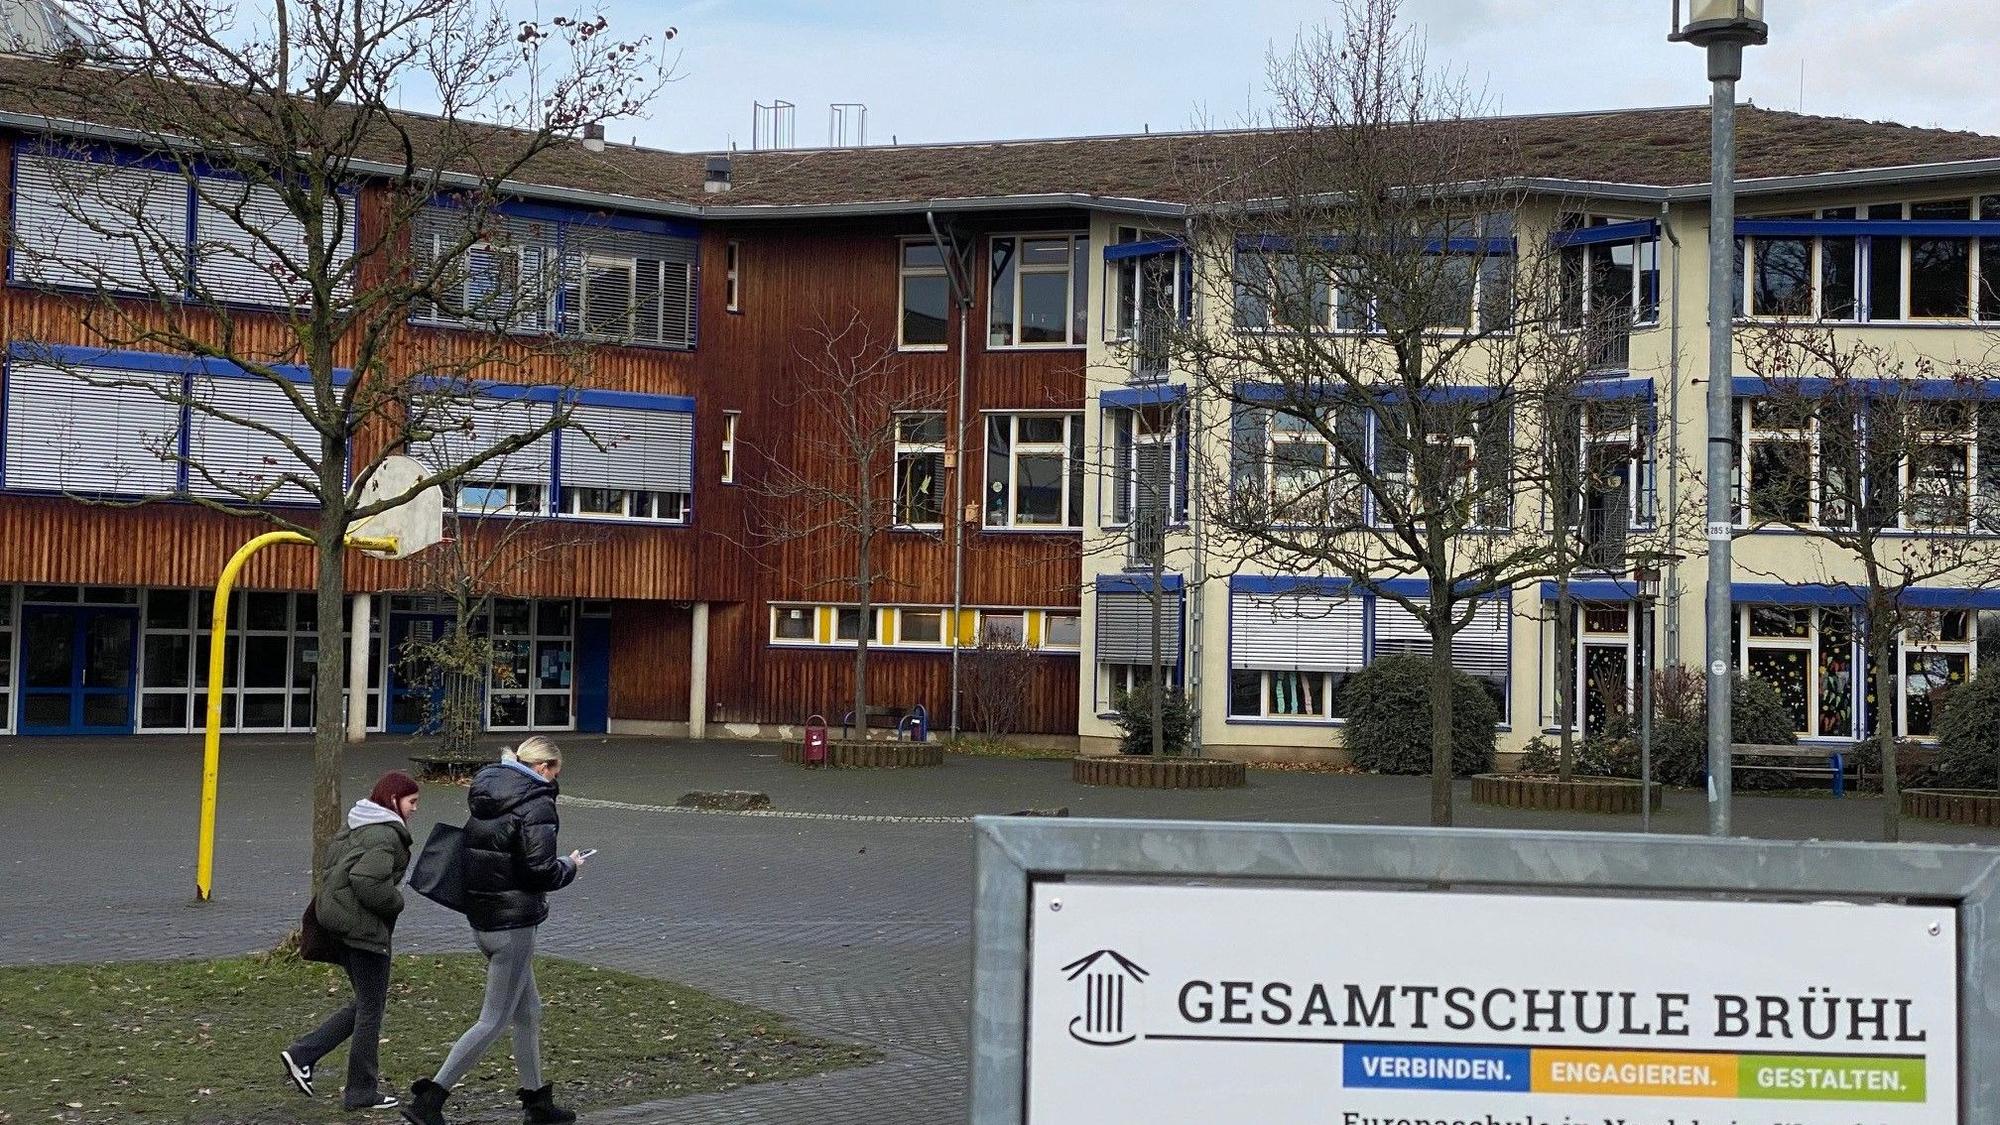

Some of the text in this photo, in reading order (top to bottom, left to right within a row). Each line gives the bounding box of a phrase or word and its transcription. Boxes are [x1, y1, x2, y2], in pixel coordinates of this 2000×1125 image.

[1178, 980, 1926, 1042] GESAMTSCHULE BRÜHL
[1362, 1056, 1907, 1092] VERBINDEN. ENGAGIEREN. GESTALTEN.
